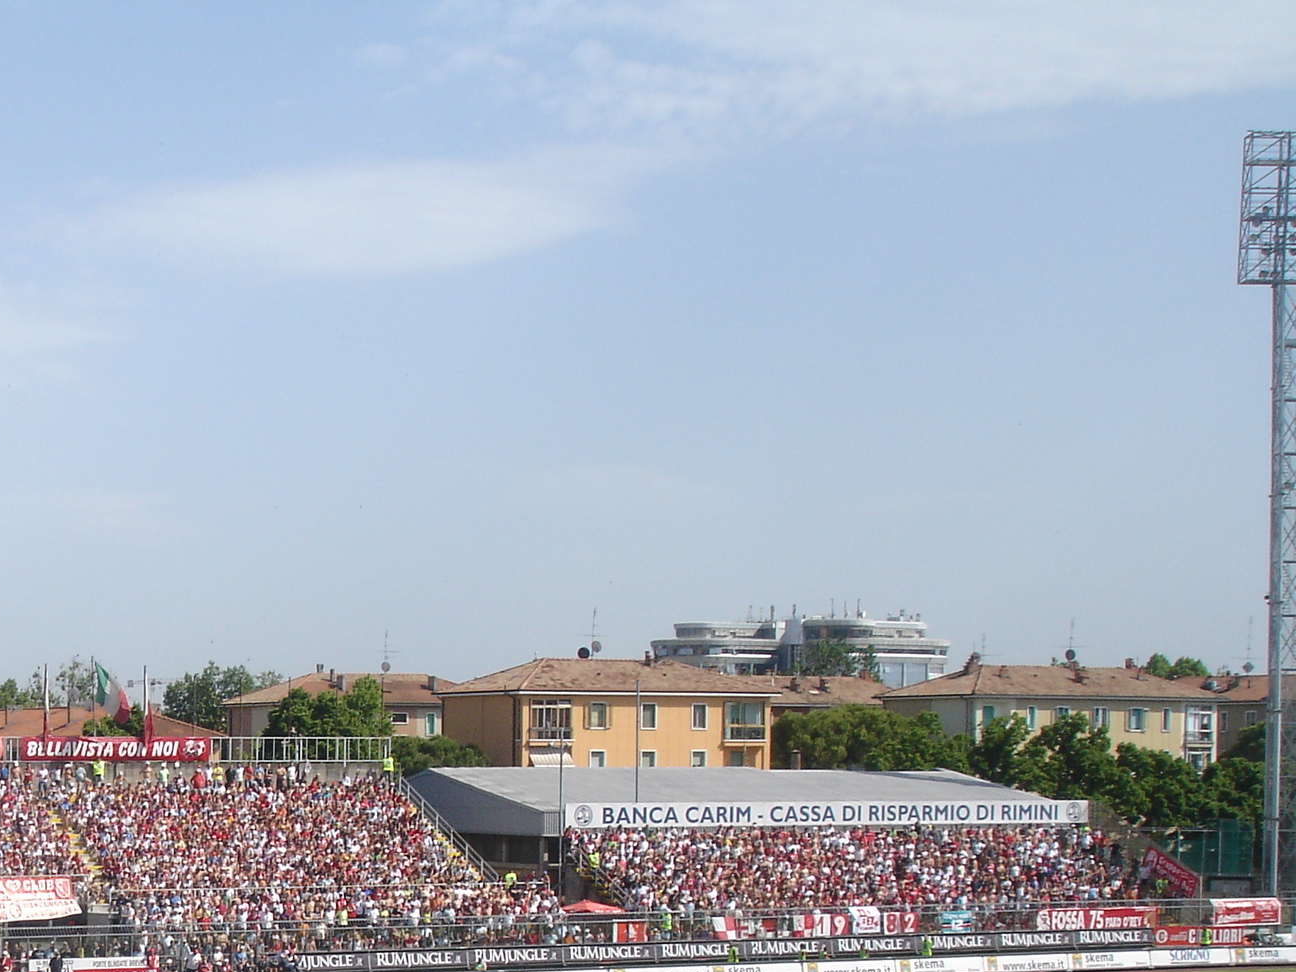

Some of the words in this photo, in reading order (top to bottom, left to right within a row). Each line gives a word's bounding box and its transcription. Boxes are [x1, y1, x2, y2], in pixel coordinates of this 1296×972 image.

[27, 741, 113, 757] BELLAVISTA
[118, 740, 147, 757] CON
[152, 740, 179, 756] NOI
[602, 807, 678, 824] BANCA
[686, 807, 751, 823] CARIM
[770, 805, 835, 822] CASSA
[842, 805, 862, 821] DI
[869, 804, 970, 821] RISPARMIO
[976, 804, 994, 820] DI
[1002, 804, 1059, 820] RIMINI
[1051, 911, 1084, 929] FOSSA
[1089, 910, 1104, 928] 75
[377, 952, 453, 968] RUMJUNGLE
[914, 959, 945, 969] skema
[1003, 959, 1065, 971] www.skema.it
[1085, 953, 1114, 963] skema
